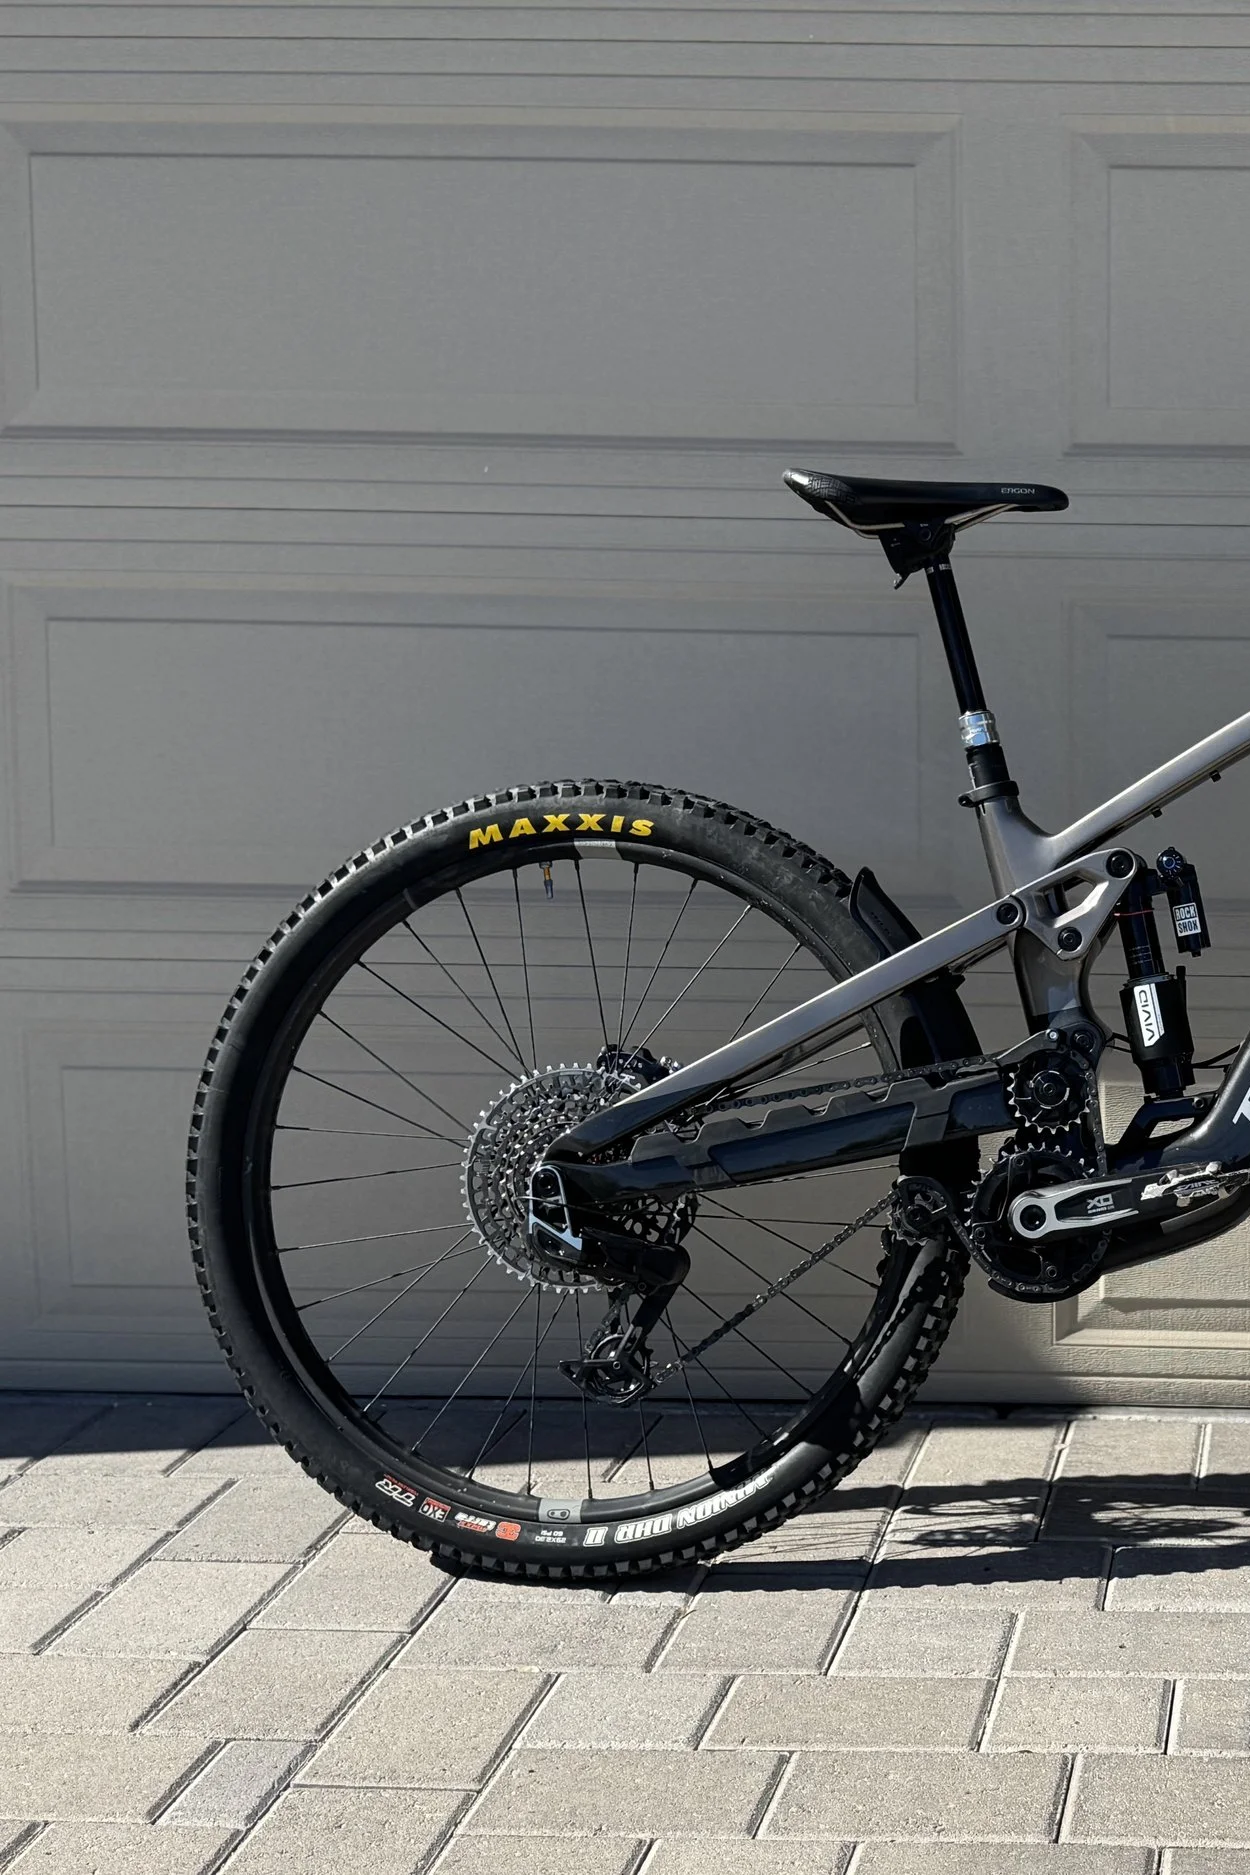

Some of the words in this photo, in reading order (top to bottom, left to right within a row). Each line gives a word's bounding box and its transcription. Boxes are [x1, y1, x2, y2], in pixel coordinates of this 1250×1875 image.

[1000, 487, 1036, 495] ERGON
[468, 813, 654, 850] MAXXIS
[1174, 905, 1196, 921] ROCK
[1178, 919, 1199, 934] SHOX
[1138, 989, 1156, 1042] VIVID
[375, 1478, 417, 1508] TR
[420, 1501, 447, 1521] EXO
[614, 1513, 673, 1544] DHR
